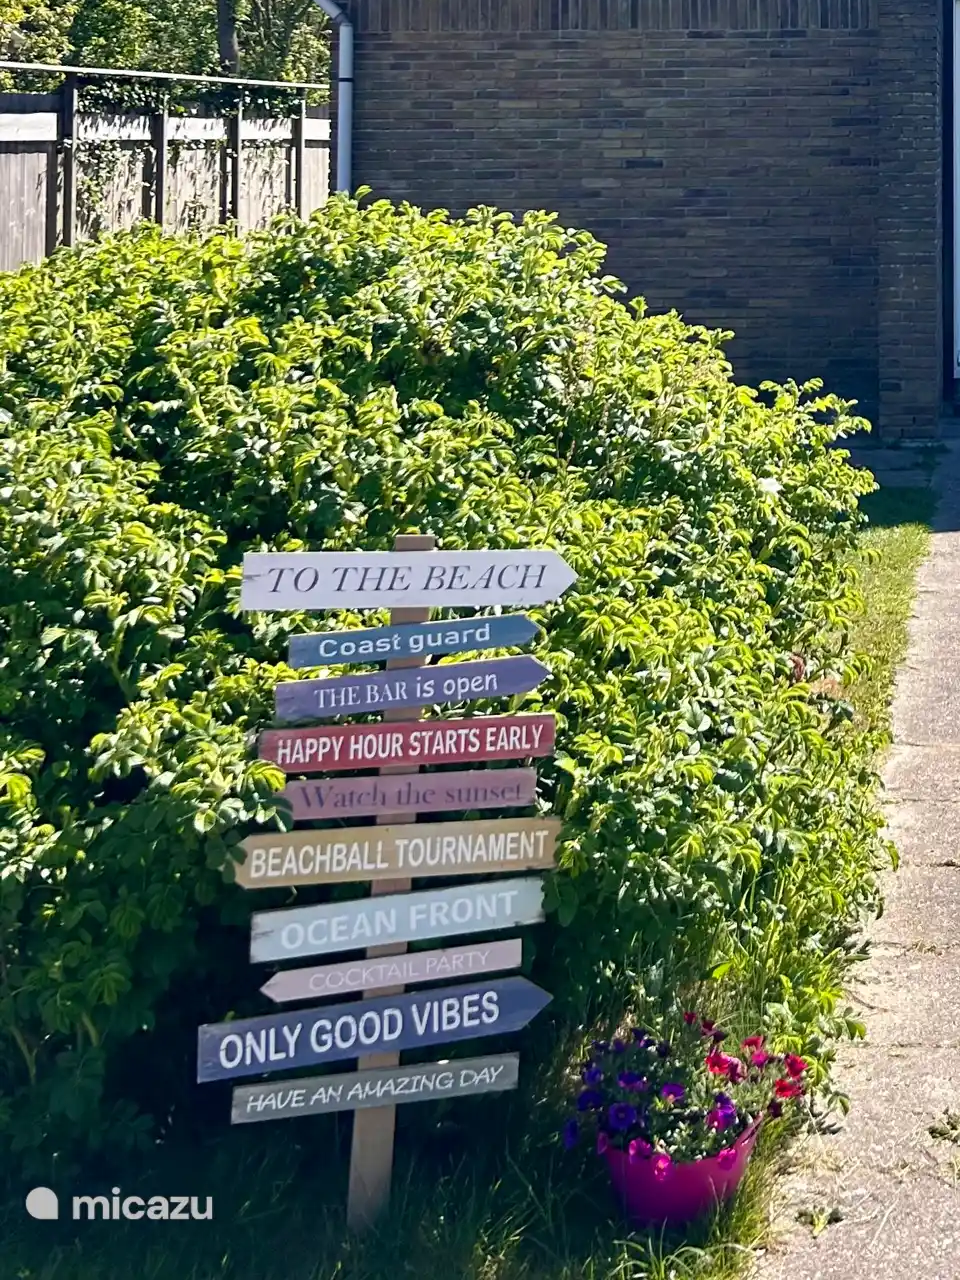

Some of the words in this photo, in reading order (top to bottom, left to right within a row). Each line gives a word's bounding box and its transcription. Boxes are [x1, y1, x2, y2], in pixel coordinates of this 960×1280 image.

[267, 566, 321, 594] TO
[332, 565, 414, 592] THE
[422, 563, 548, 591] BEACH
[319, 632, 401, 658] Coast
[408, 623, 491, 653] guard
[314, 686, 362, 709] THE
[365, 681, 408, 704] BAR
[416, 676, 435, 699] is
[442, 673, 498, 700] open
[277, 736, 345, 764] HAPPY
[348, 732, 404, 760] HOUR
[408, 727, 481, 757] STARTS
[485, 724, 544, 752] EARLY
[299, 783, 387, 809] Watch
[396, 782, 436, 805] the
[445, 780, 522, 803] sunset
[250, 840, 390, 879] BEACHBALL
[395, 830, 549, 867] TOURNAMENT
[281, 910, 397, 949] OCEAN
[409, 890, 519, 931] FRONT
[309, 962, 420, 991] COCKTAIL
[425, 949, 492, 975] PARTY
[218, 1023, 304, 1070] ONLY
[310, 1008, 403, 1053] GOOD
[412, 990, 500, 1037] VIBES
[247, 1085, 306, 1114] HAVE
[310, 1084, 343, 1105] AN
[346, 1069, 454, 1101] AMAZING
[458, 1065, 505, 1086] DAY
